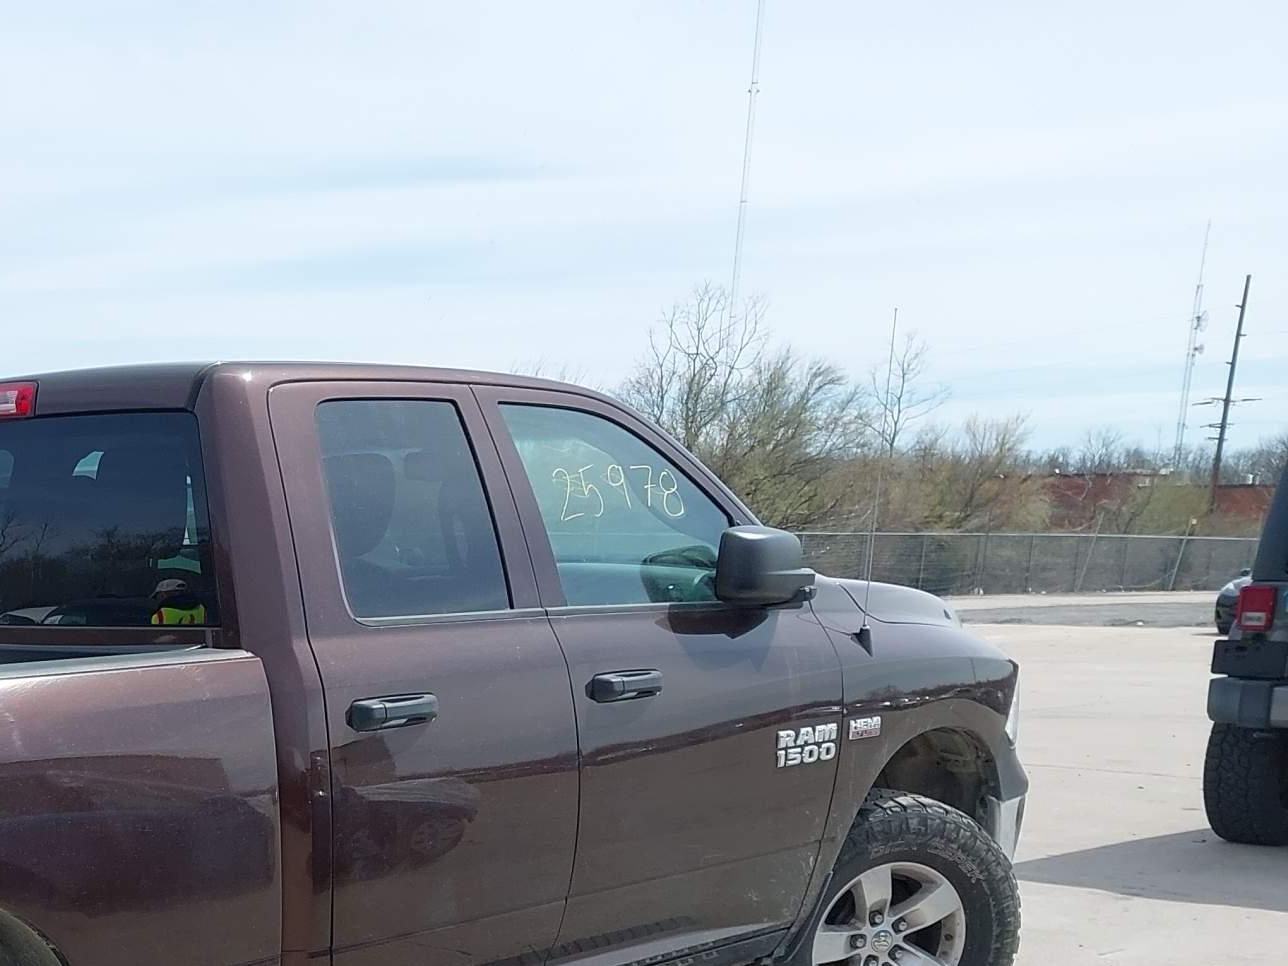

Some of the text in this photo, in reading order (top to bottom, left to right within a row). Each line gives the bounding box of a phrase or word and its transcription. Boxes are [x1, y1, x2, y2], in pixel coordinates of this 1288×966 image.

[552, 463, 685, 521] 25978
[776, 722, 838, 748] RAM
[776, 742, 836, 768] 1500
